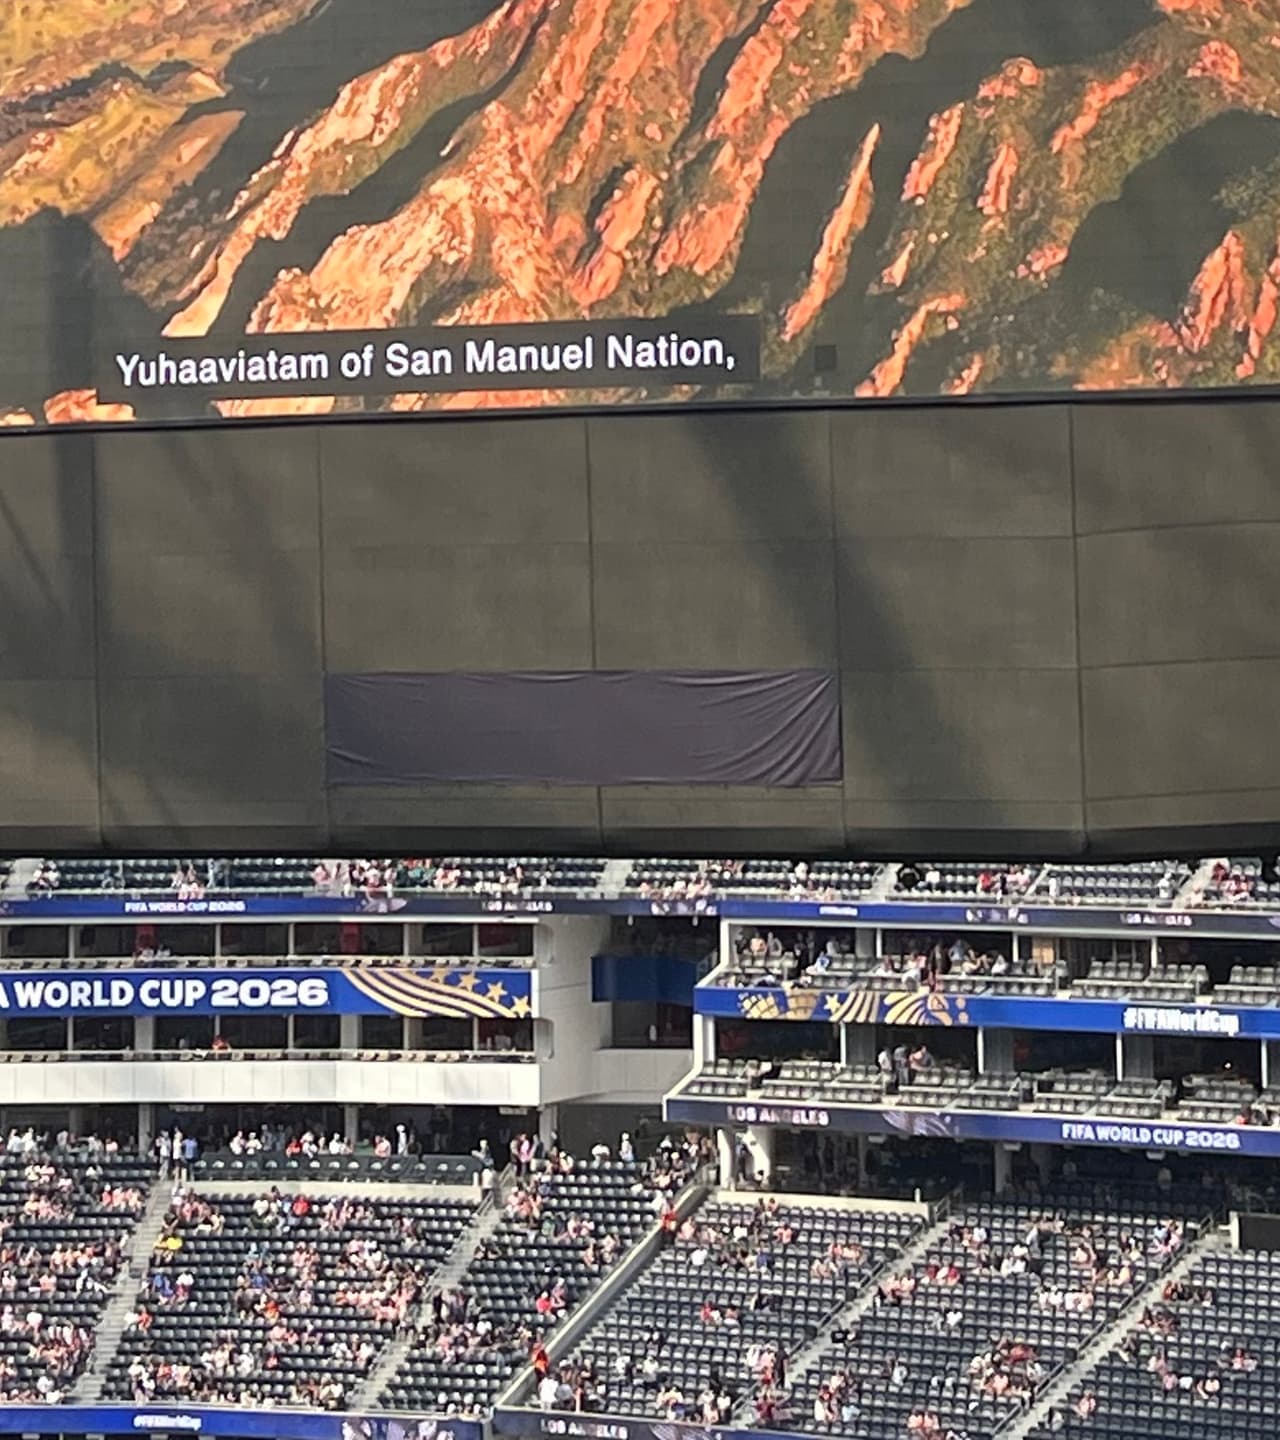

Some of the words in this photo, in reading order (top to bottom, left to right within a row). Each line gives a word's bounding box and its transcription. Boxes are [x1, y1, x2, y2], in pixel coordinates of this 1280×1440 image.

[116, 351, 331, 388] Yuhaaviatam
[340, 345, 375, 379] of
[385, 341, 454, 377] San
[465, 335, 594, 373] Manuel
[607, 333, 736, 370] Nation,
[148, 902, 186, 913] WORLD
[187, 902, 208, 912] CUP
[14, 982, 135, 1009] WORLD
[138, 980, 206, 1008] CUP
[210, 979, 329, 1007] 2026
[1062, 1123, 1095, 1140] FIFA
[1096, 1126, 1151, 1143] WORLD
[1153, 1129, 1184, 1145] CUP
[1185, 1130, 1240, 1149] 2026
